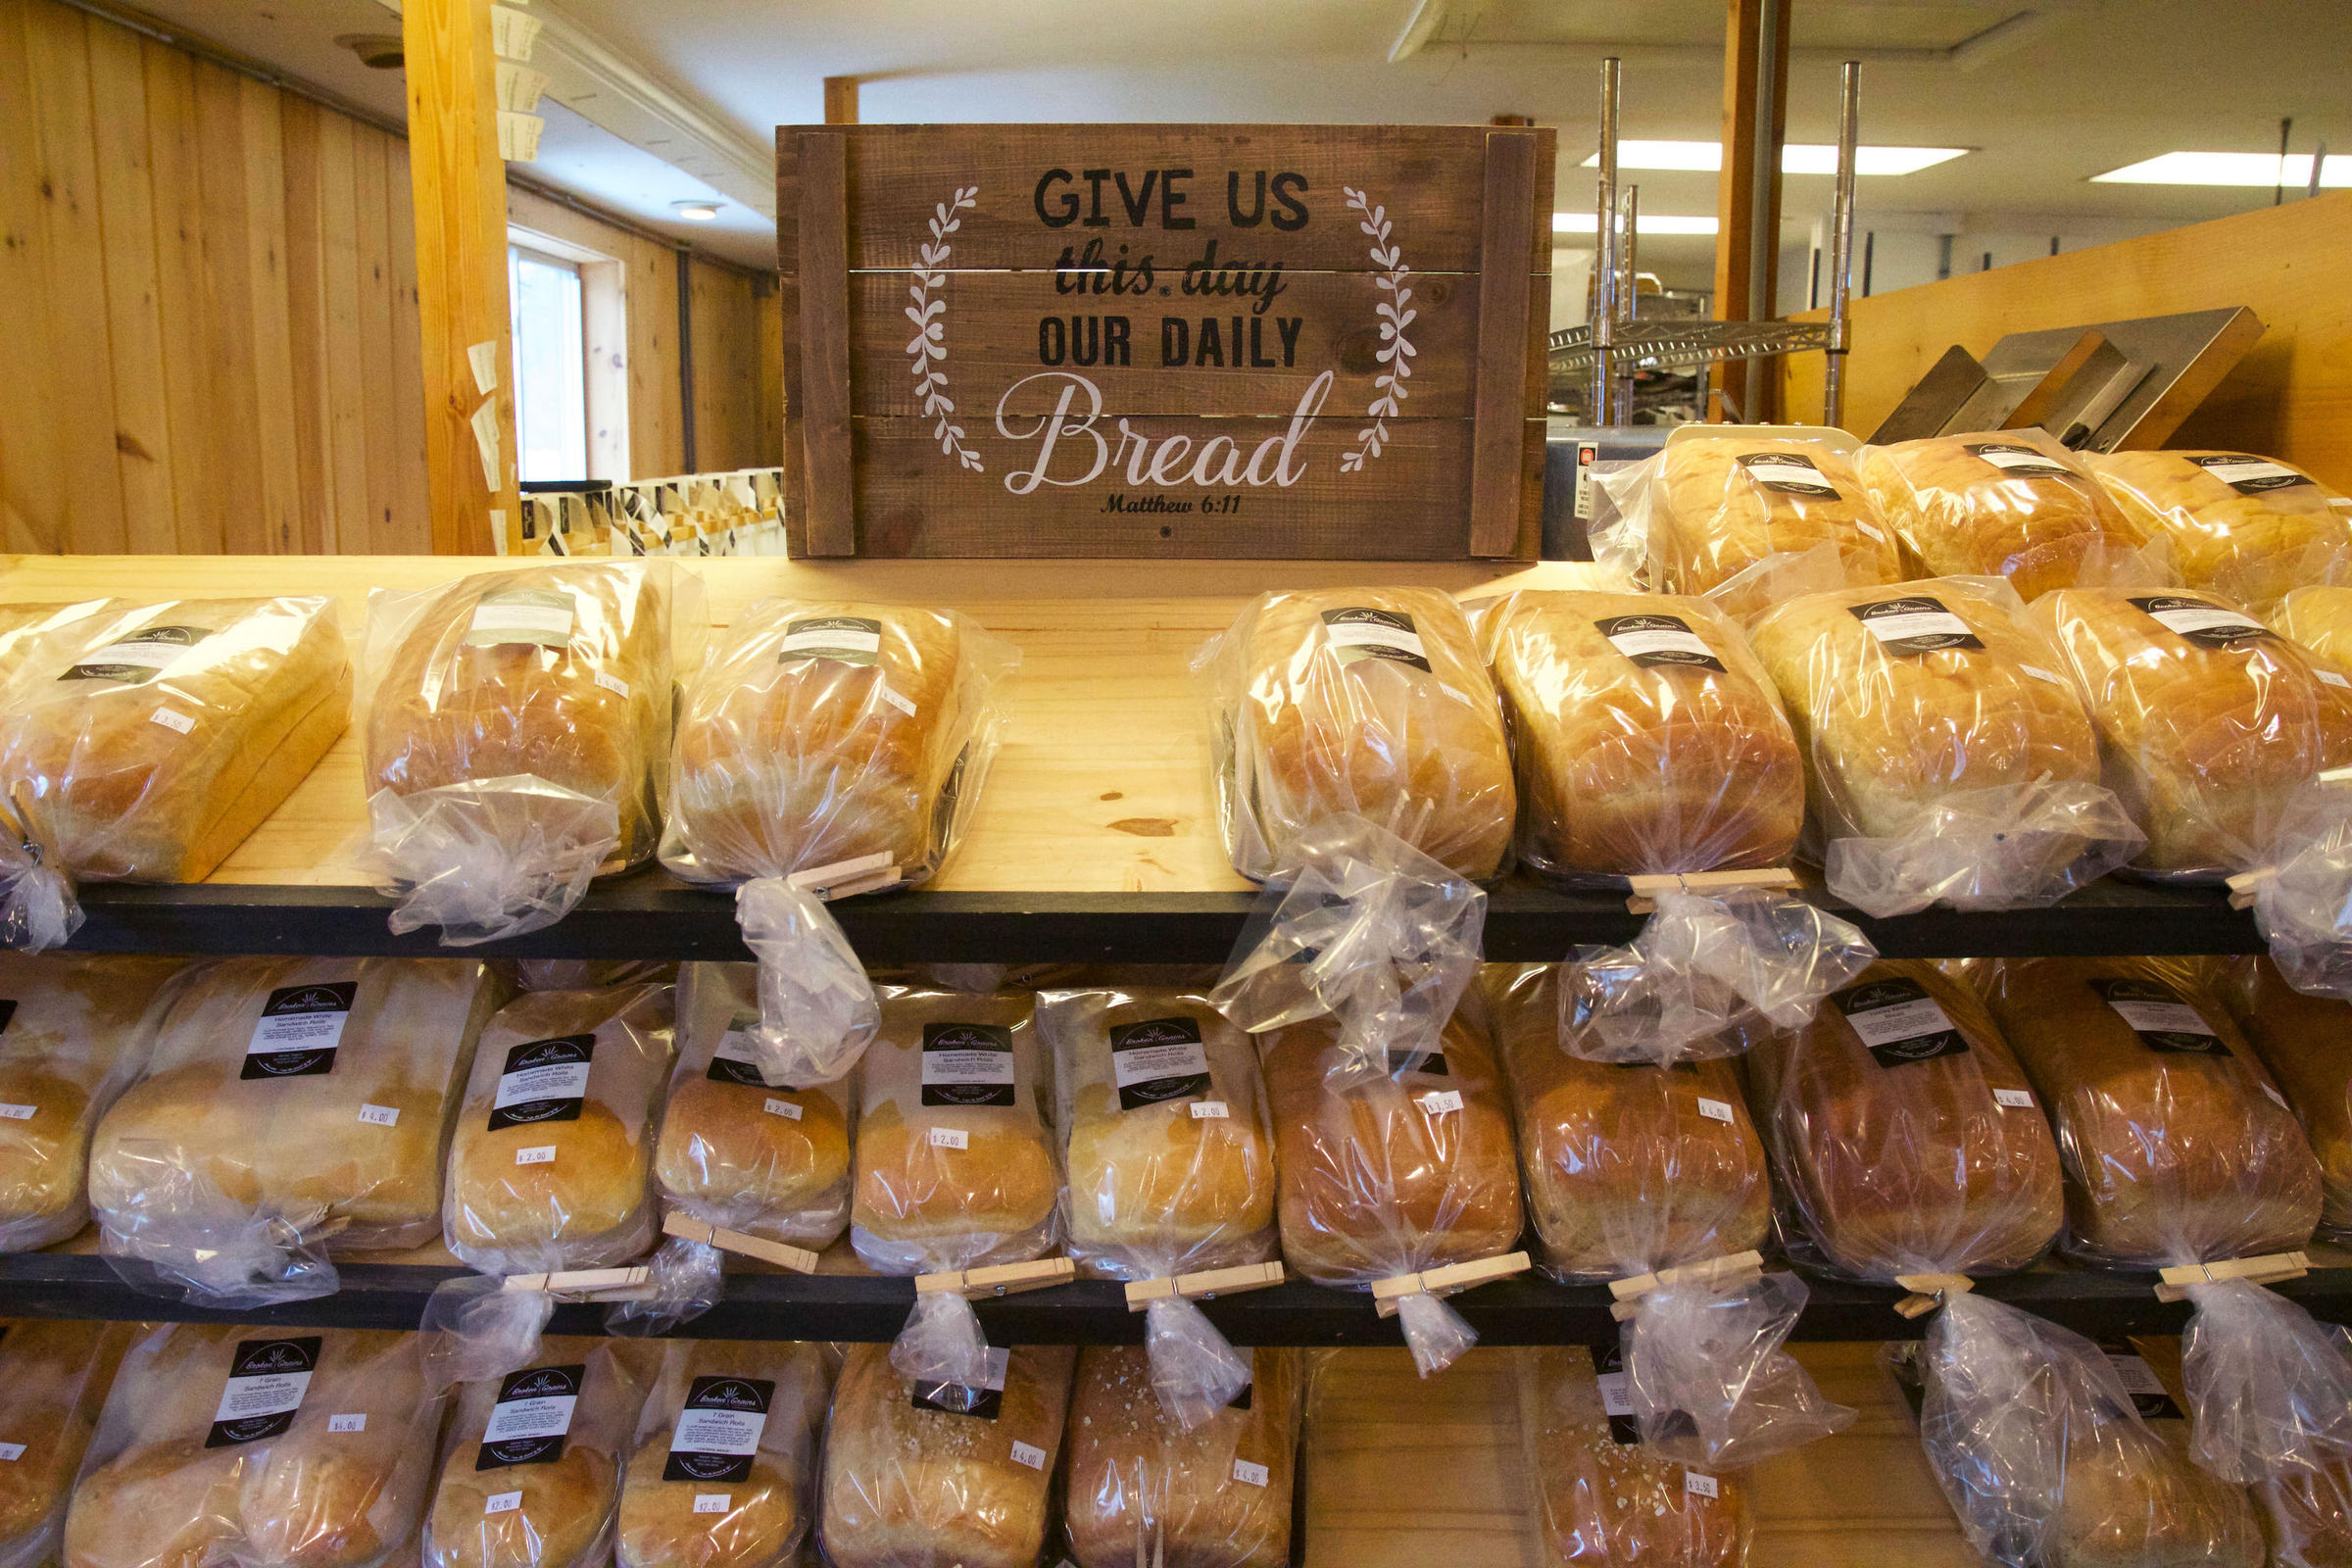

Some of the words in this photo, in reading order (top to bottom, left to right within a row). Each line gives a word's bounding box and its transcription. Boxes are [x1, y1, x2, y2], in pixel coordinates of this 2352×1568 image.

[1033, 168, 1197, 230] GIVE
[1227, 170, 1309, 231] US
[1054, 237, 1154, 295] this
[1181, 239, 1288, 315] day
[1038, 316, 1131, 368] OUR
[1162, 316, 1303, 368] DAILY
[995, 369, 1335, 495] Bread
[1100, 493, 1194, 514] Matthew
[1200, 494, 1241, 514] 6:11
